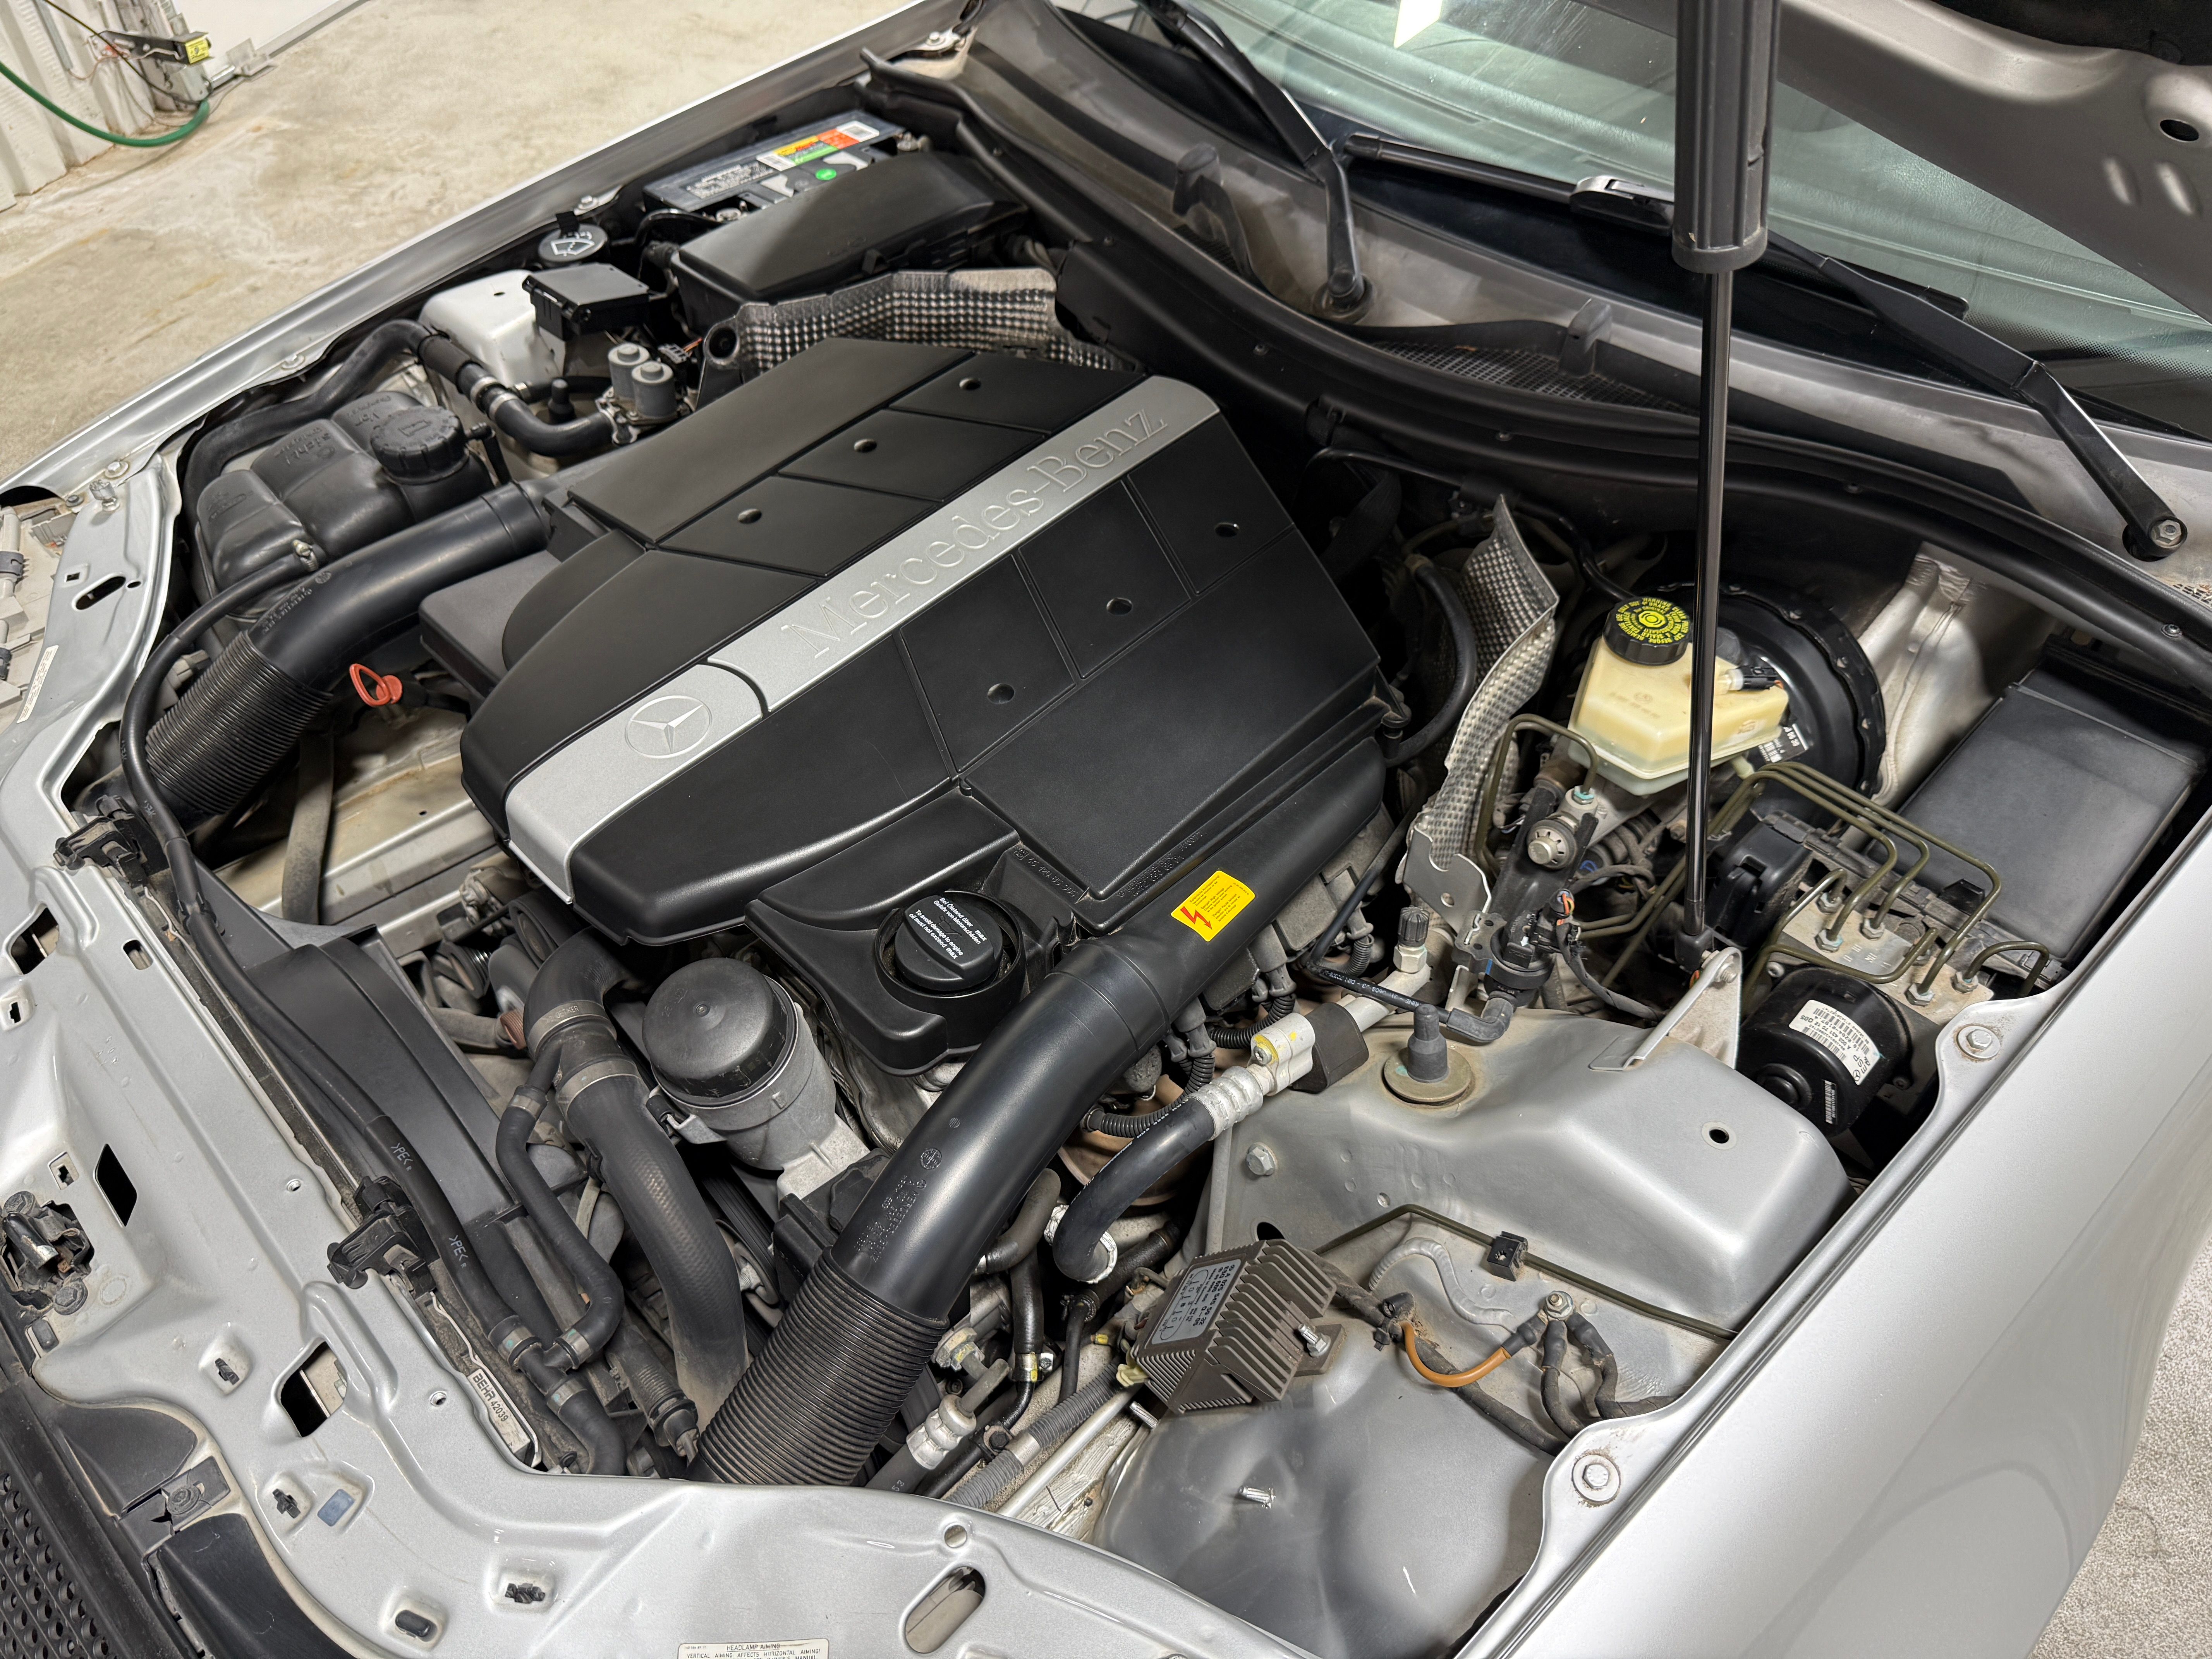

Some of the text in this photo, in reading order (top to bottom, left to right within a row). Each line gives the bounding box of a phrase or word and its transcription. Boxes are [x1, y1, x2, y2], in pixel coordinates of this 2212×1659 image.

[779, 408, 1170, 659] Mercedes-Benz
[908, 911, 958, 960] oil must not exceed max
[920, 913, 933, 926] avoid
[929, 922, 947, 939] damage
[948, 940, 964, 957] engine
[933, 899, 982, 945] Gefahr von Motorschäden
[946, 902, 965, 920] Ölstand
[962, 916, 974, 928] über
[974, 929, 987, 942] max
[1828, 1030, 1839, 1039] 431
[1850, 1053, 1869, 1074] ESP
[472, 1372, 509, 1423] BEHR 42039
